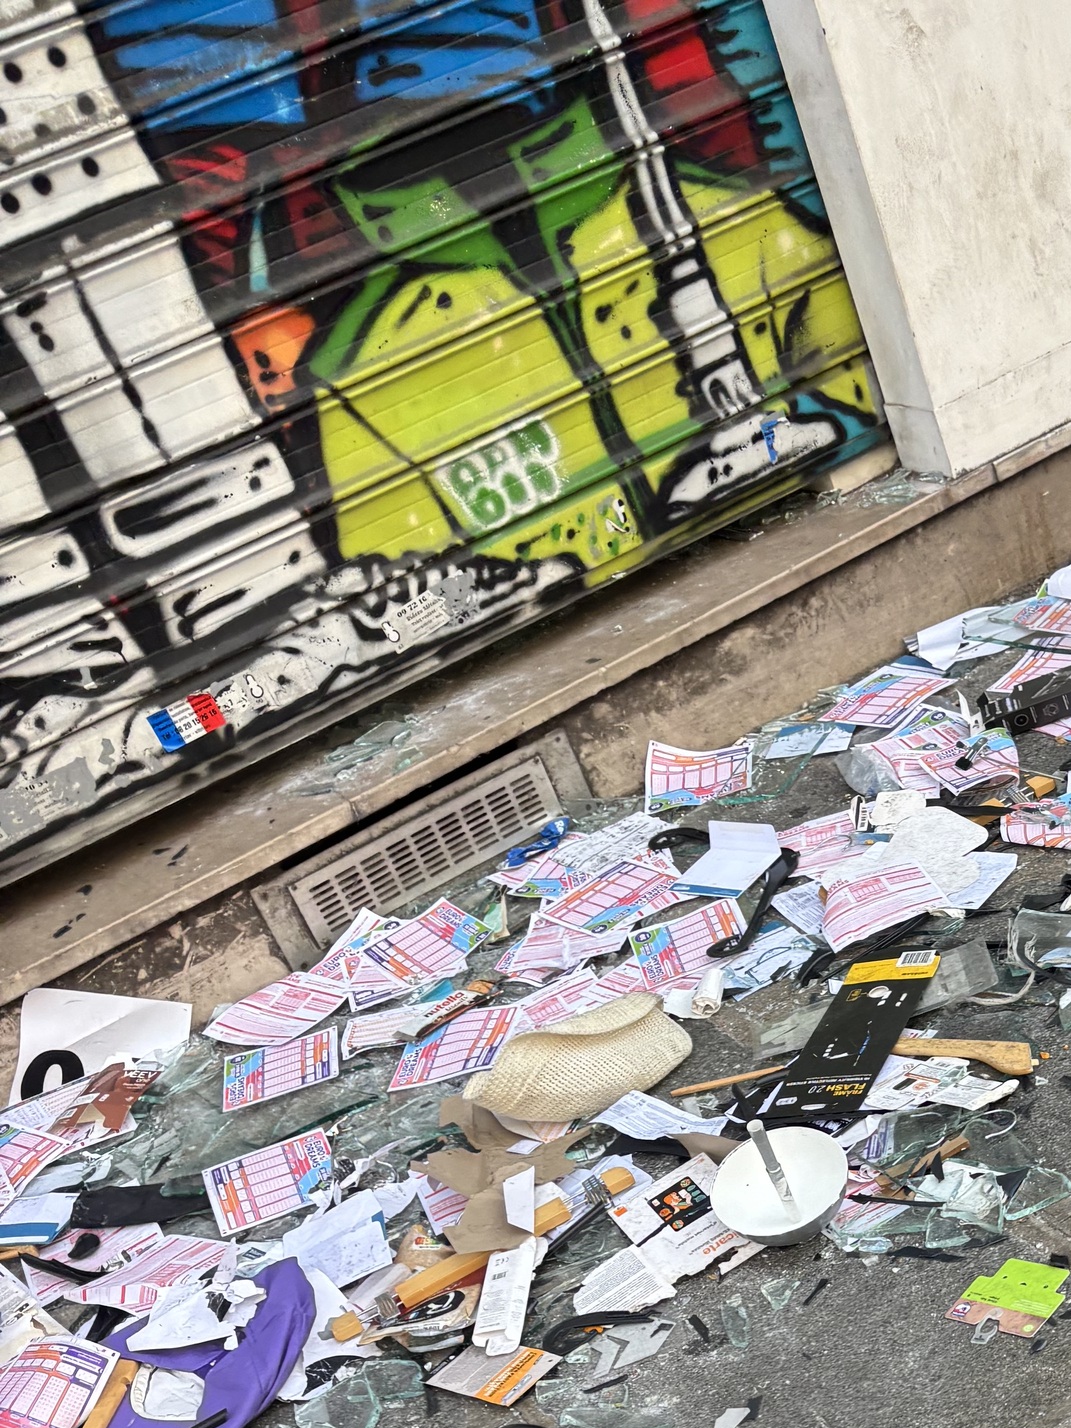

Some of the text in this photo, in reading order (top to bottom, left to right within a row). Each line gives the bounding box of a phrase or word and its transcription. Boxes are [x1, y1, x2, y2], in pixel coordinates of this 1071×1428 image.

[397, 609, 407, 618] 09
[408, 602, 418, 610] 72
[424, 992, 465, 1018] nutella
[124, 1070, 158, 1079] VEEV
[825, 1083, 867, 1092] FLASH
